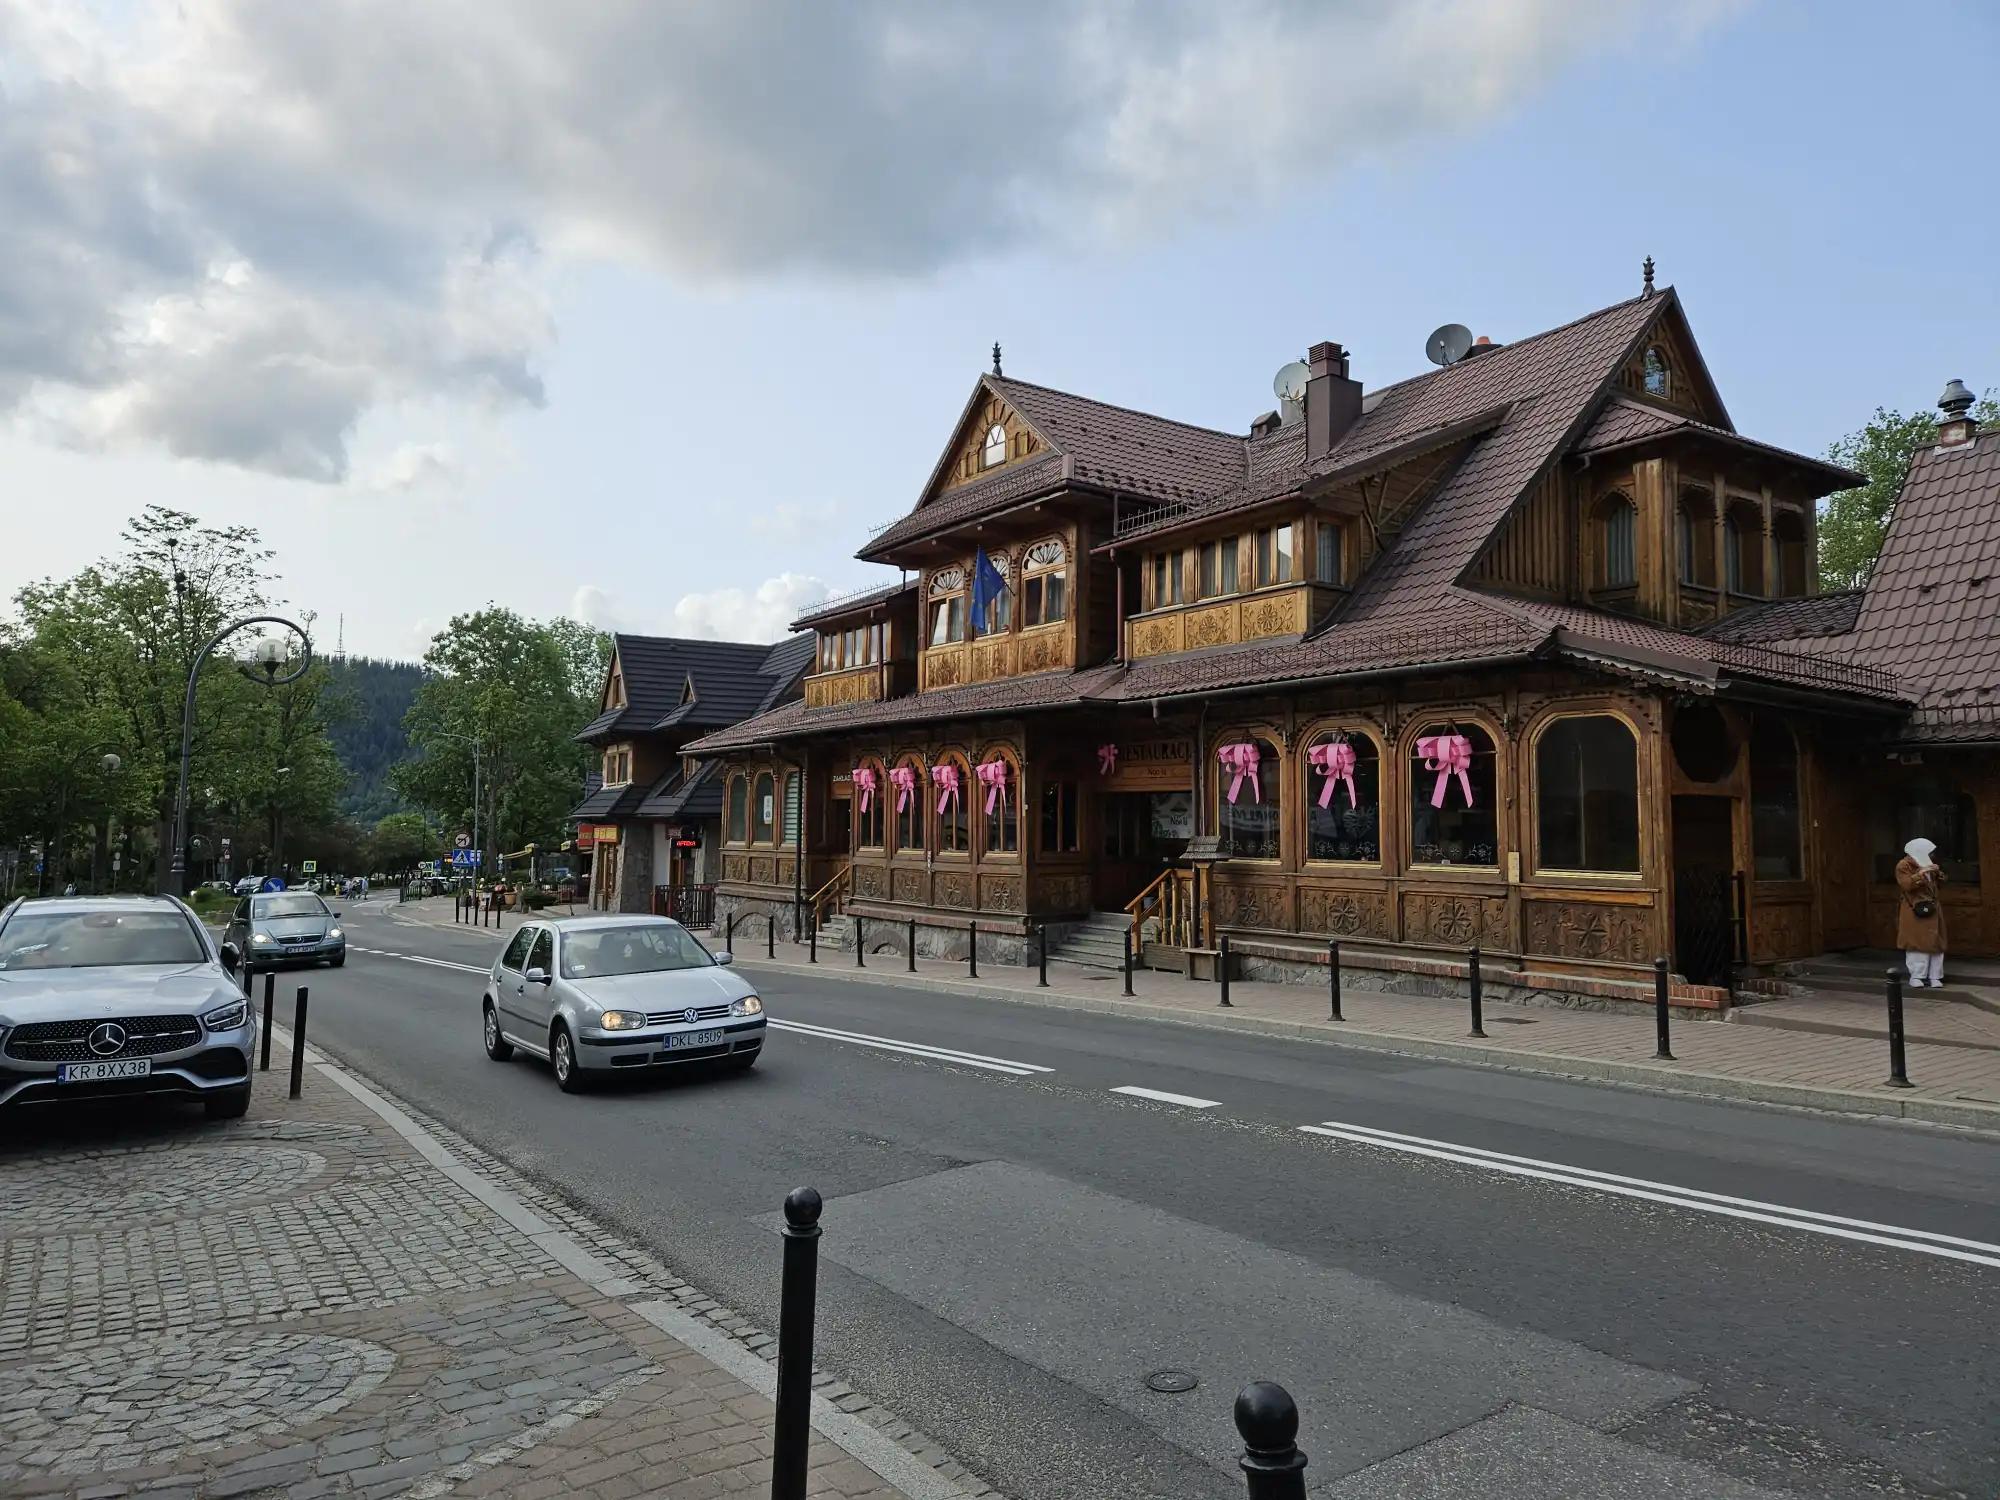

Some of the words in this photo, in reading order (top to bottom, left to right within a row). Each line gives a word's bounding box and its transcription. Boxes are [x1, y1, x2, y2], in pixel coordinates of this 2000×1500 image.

[1119, 743, 1192, 762] RESTAURACJ
[671, 1035, 695, 1047] DKL
[697, 1031, 722, 1044] 85U9
[68, 1065, 91, 1080] KR
[96, 1061, 147, 1077] 8XX38
